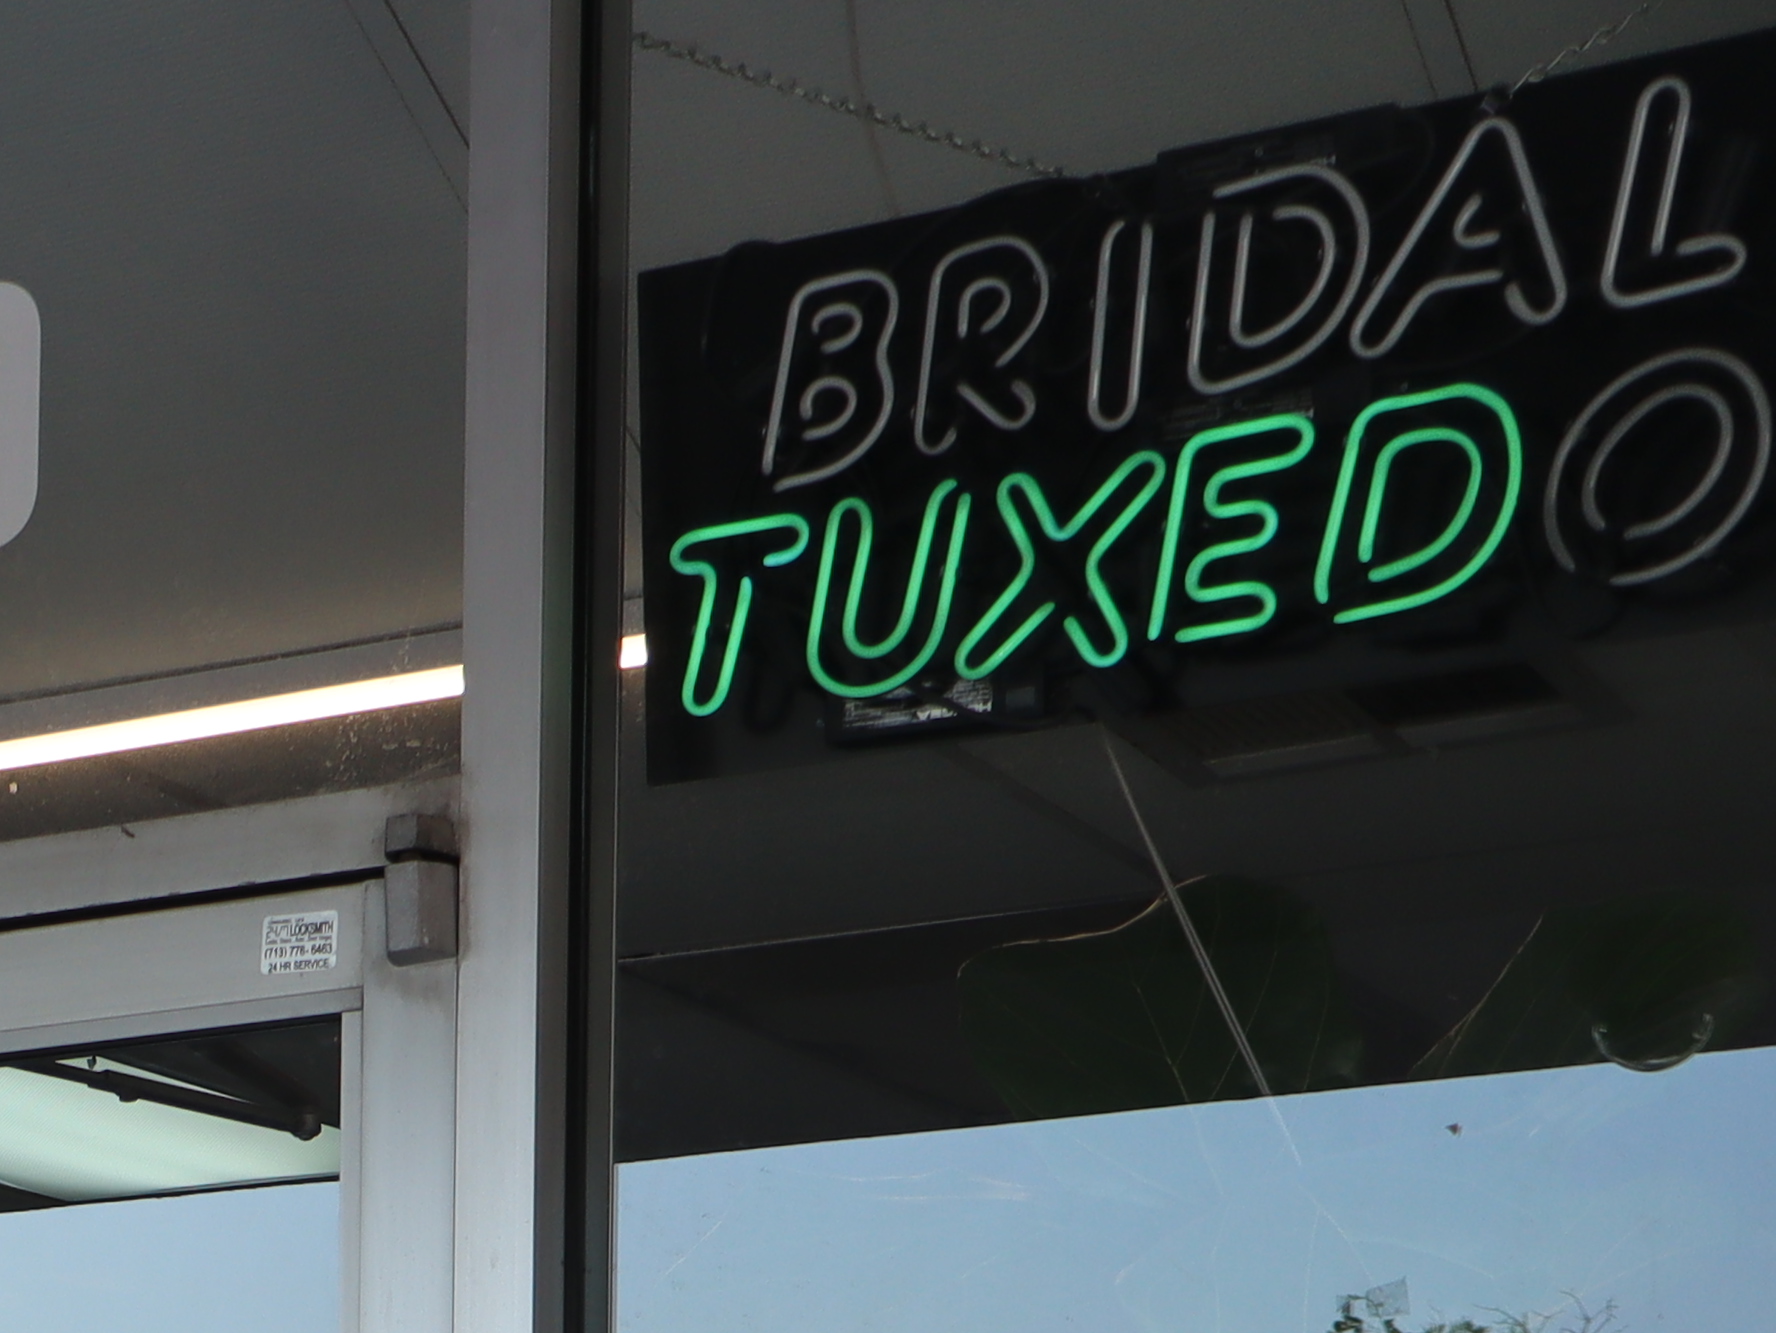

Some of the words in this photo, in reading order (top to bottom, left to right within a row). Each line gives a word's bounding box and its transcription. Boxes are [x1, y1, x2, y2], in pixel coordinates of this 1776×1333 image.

[762, 75, 1748, 492] BRIDAL
[668, 345, 1776, 718] TUXEDO
[264, 947, 287, 960] (713)
[279, 961, 291, 972] HR
[293, 958, 329, 971] SERVICE
